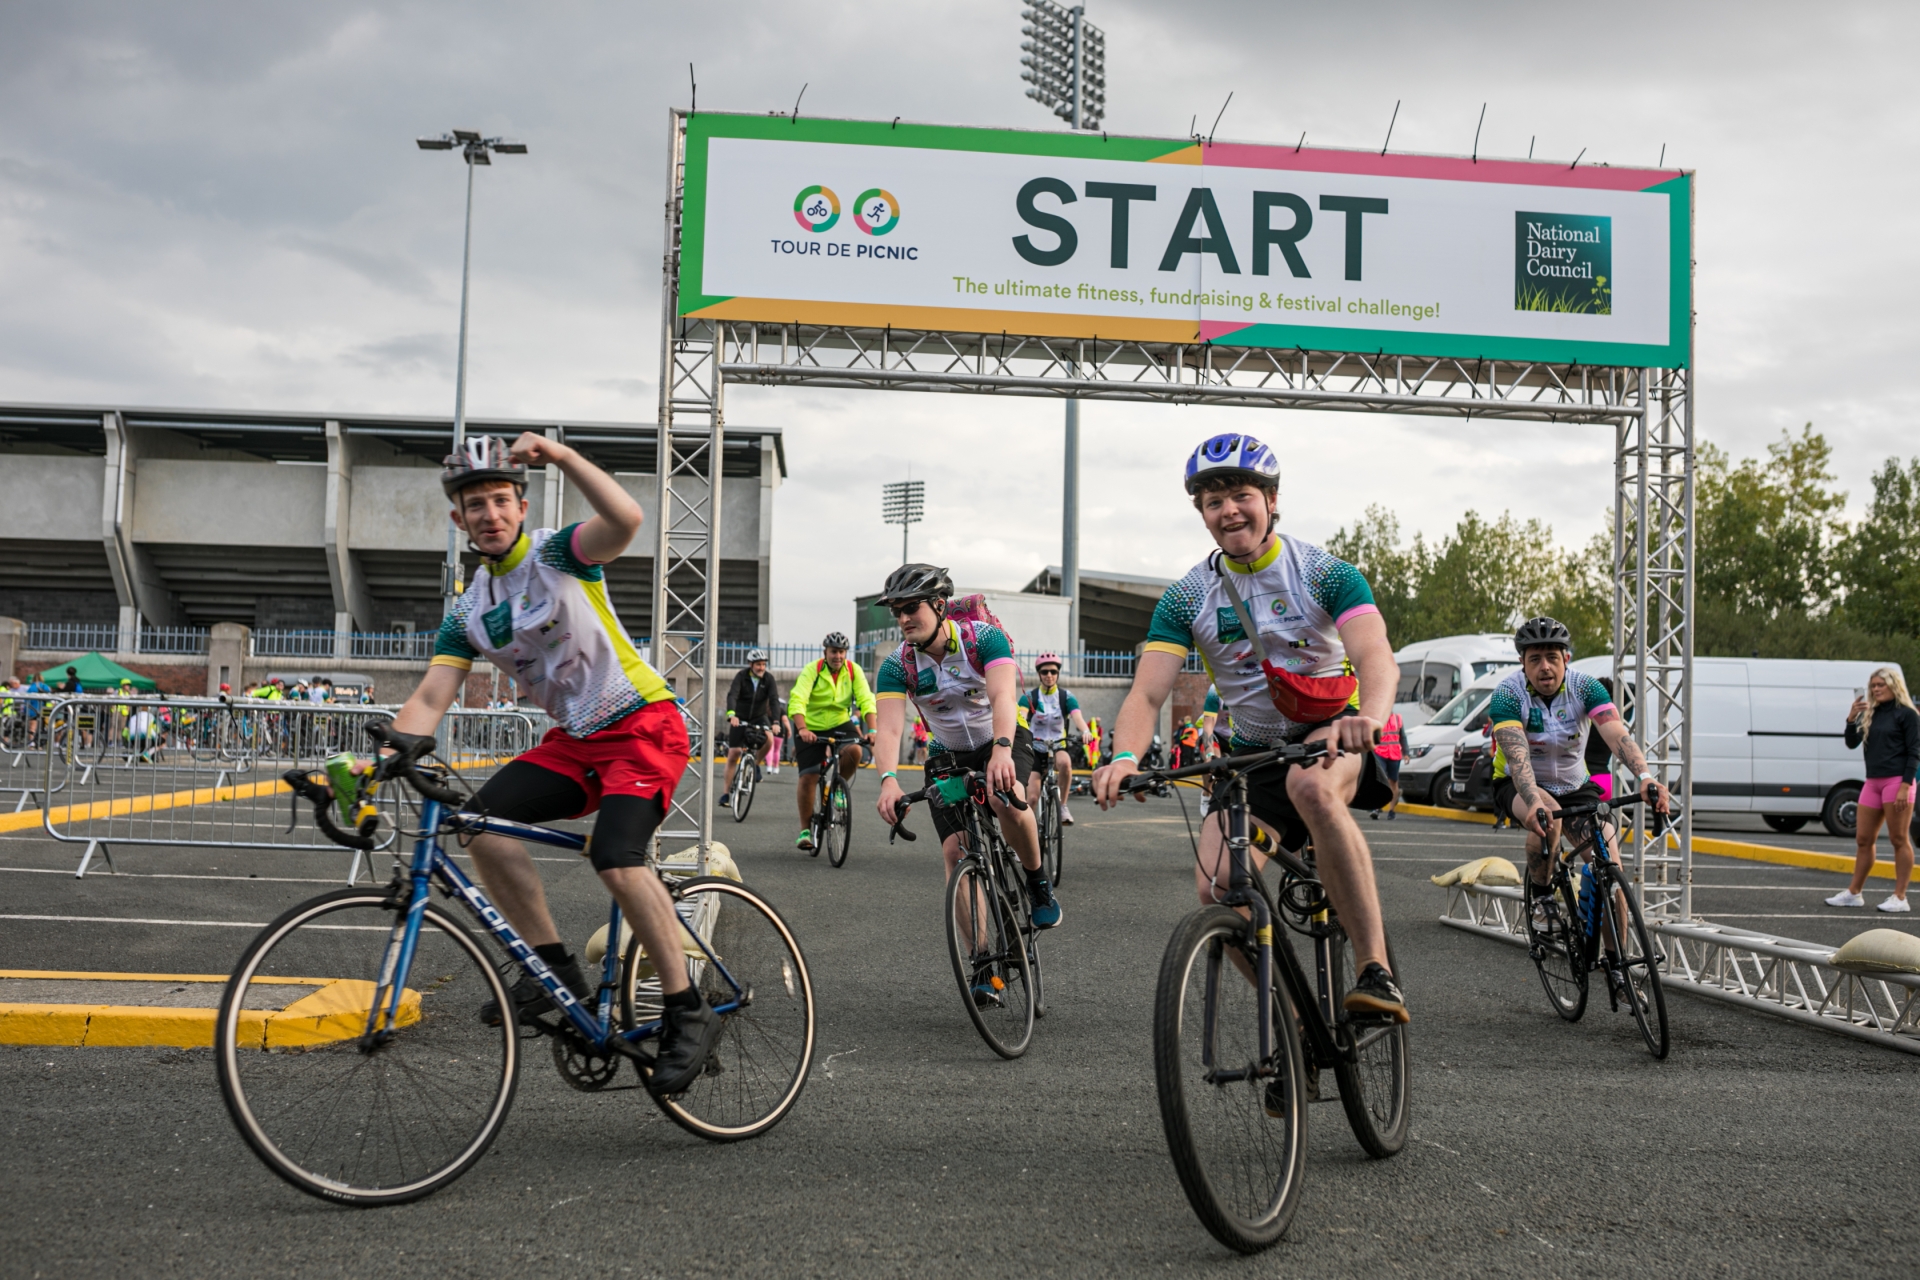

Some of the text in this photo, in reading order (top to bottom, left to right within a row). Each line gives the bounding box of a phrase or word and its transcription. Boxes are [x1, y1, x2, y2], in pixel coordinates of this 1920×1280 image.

[1011, 175, 1389, 281] START
[1526, 222, 1600, 243] National
[771, 239, 919, 261] TOUR DE PICNIC
[1526, 240, 1577, 263] Dairy
[1526, 258, 1593, 279] Council
[952, 276, 1441, 320] The ultimate fitness, fundraising & festival challenge!
[1288, 638, 1310, 649] FUL
[964, 687, 978, 698] FUL
